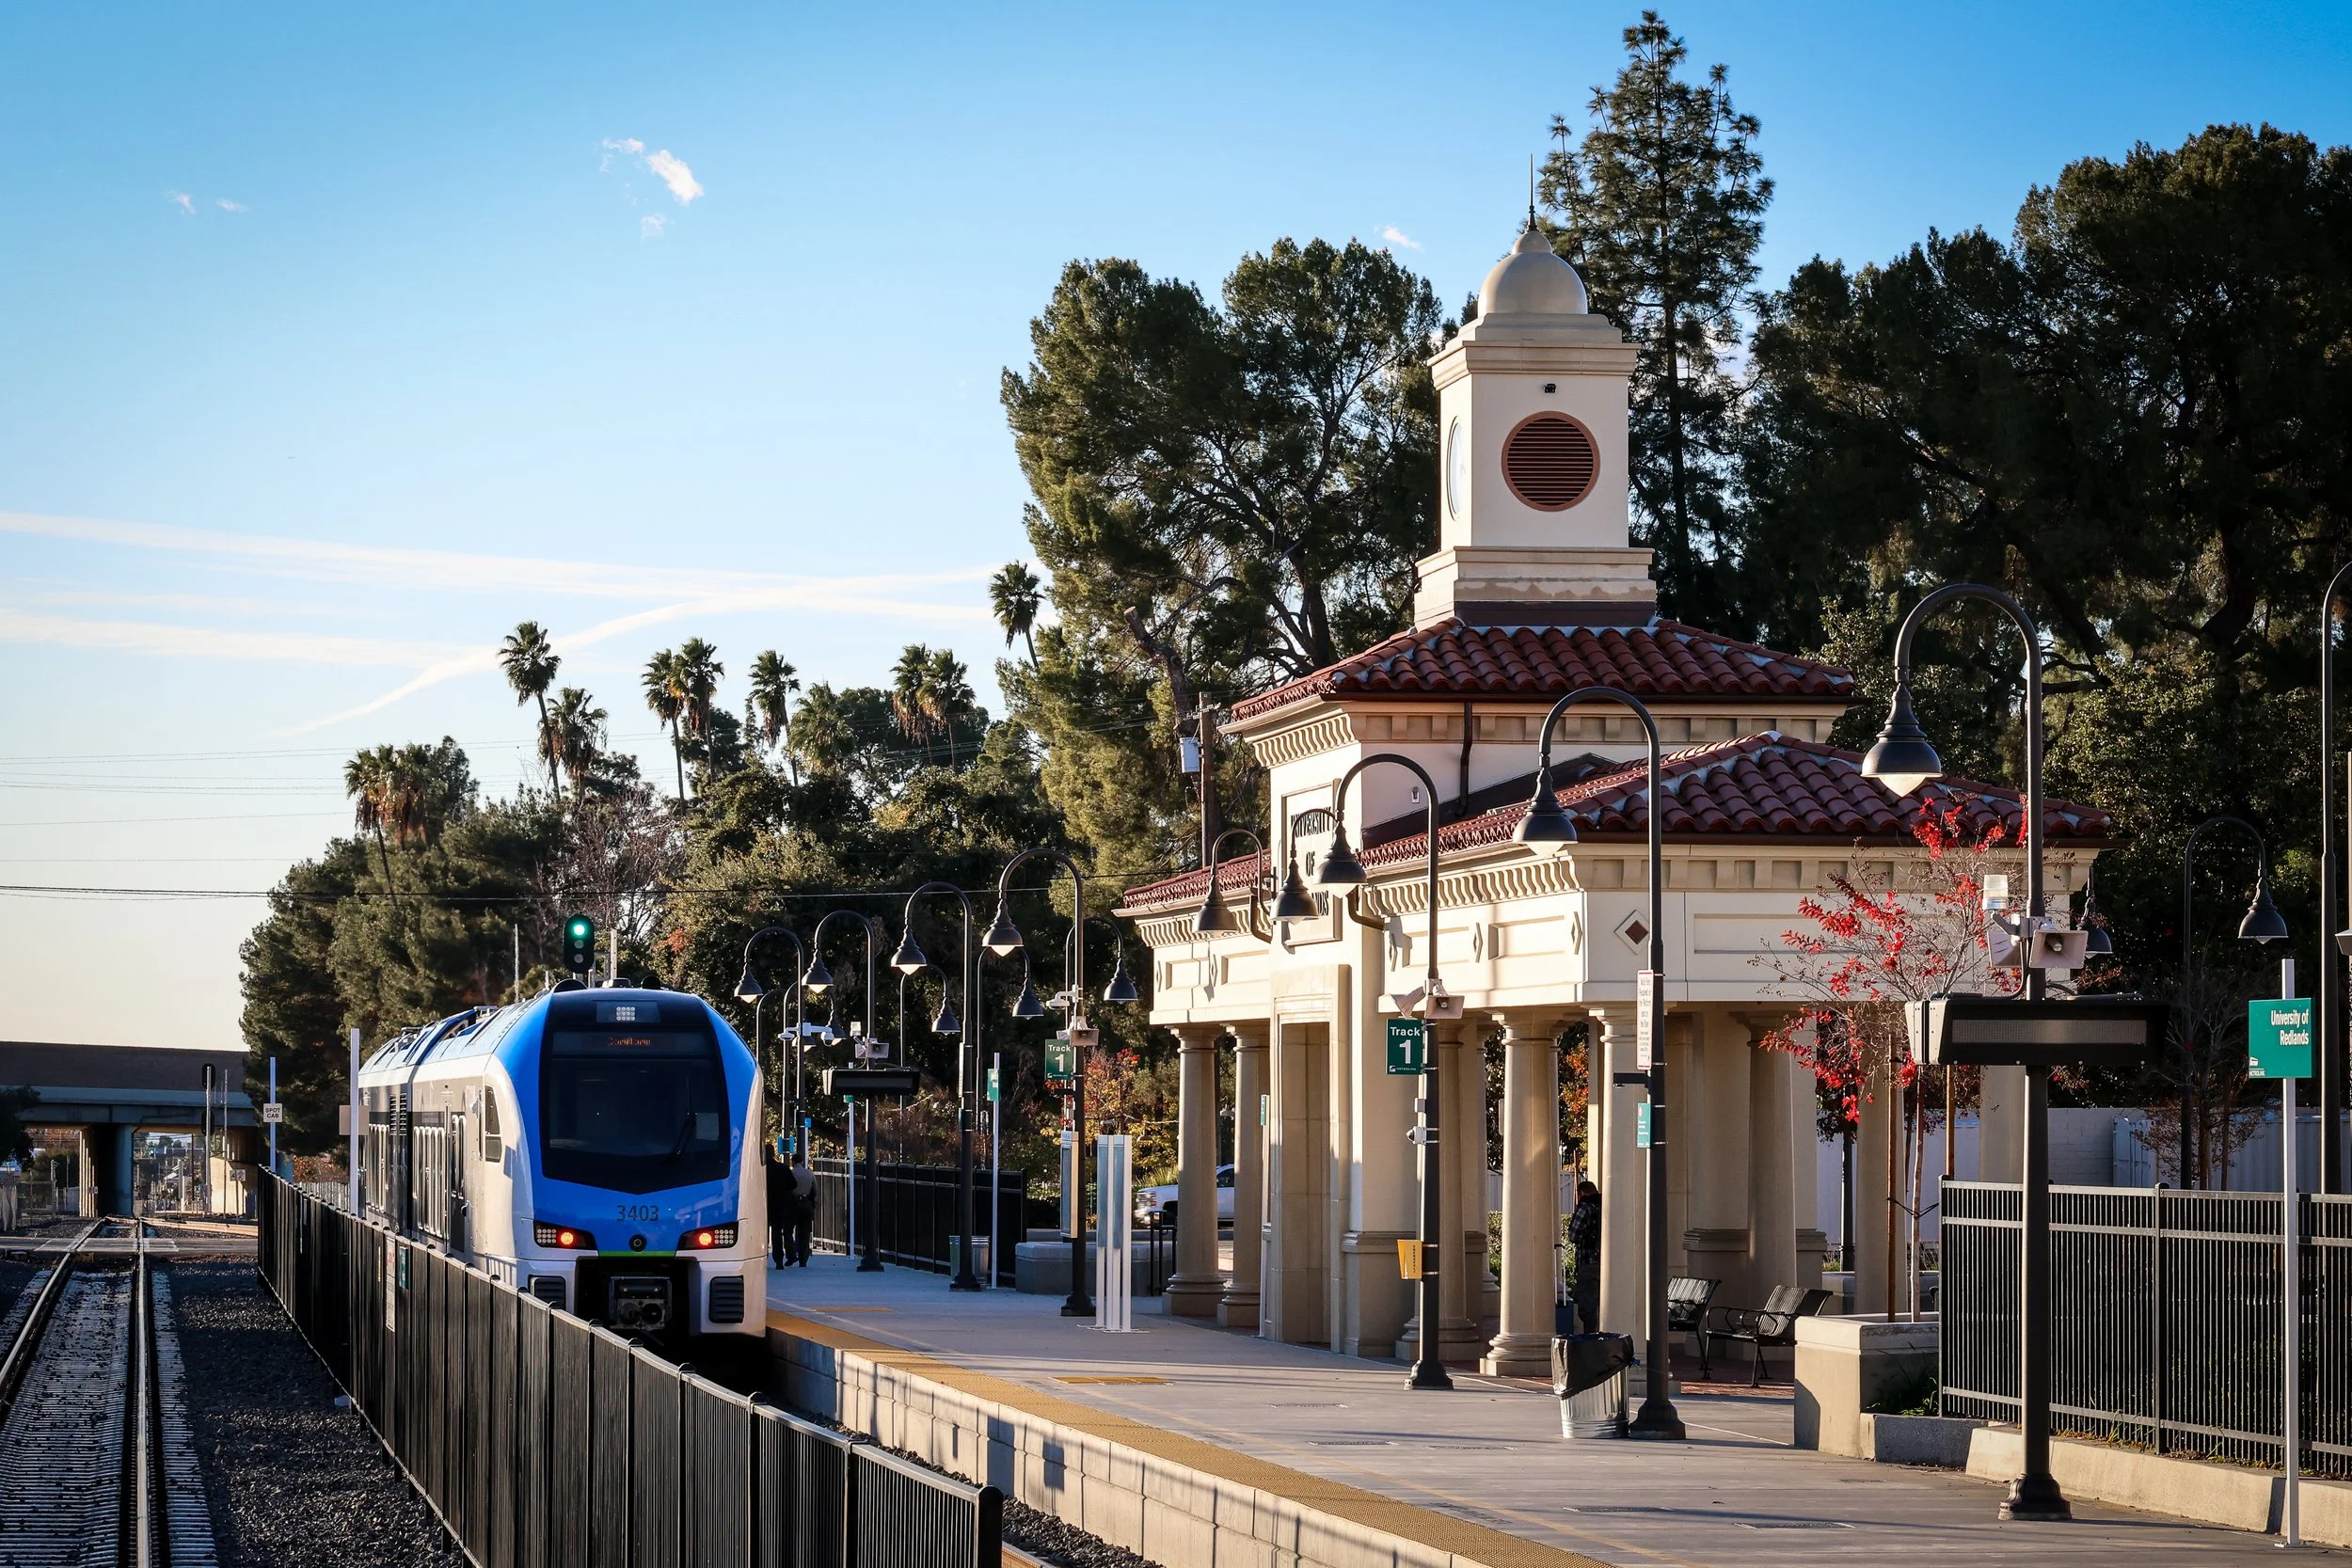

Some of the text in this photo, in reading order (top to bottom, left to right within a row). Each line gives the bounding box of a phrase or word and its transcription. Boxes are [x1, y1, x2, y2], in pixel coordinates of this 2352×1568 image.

[1306, 851, 1315, 877] OF
[2270, 1008, 2309, 1028] University of
[1390, 1026, 1421, 1037] Track
[2280, 1029, 2309, 1046] Redlands
[1048, 1044, 1072, 1053] Track
[1399, 1039, 1411, 1064] 1
[1055, 1053, 1064, 1072] 1
[616, 1205, 660, 1222] 3403
